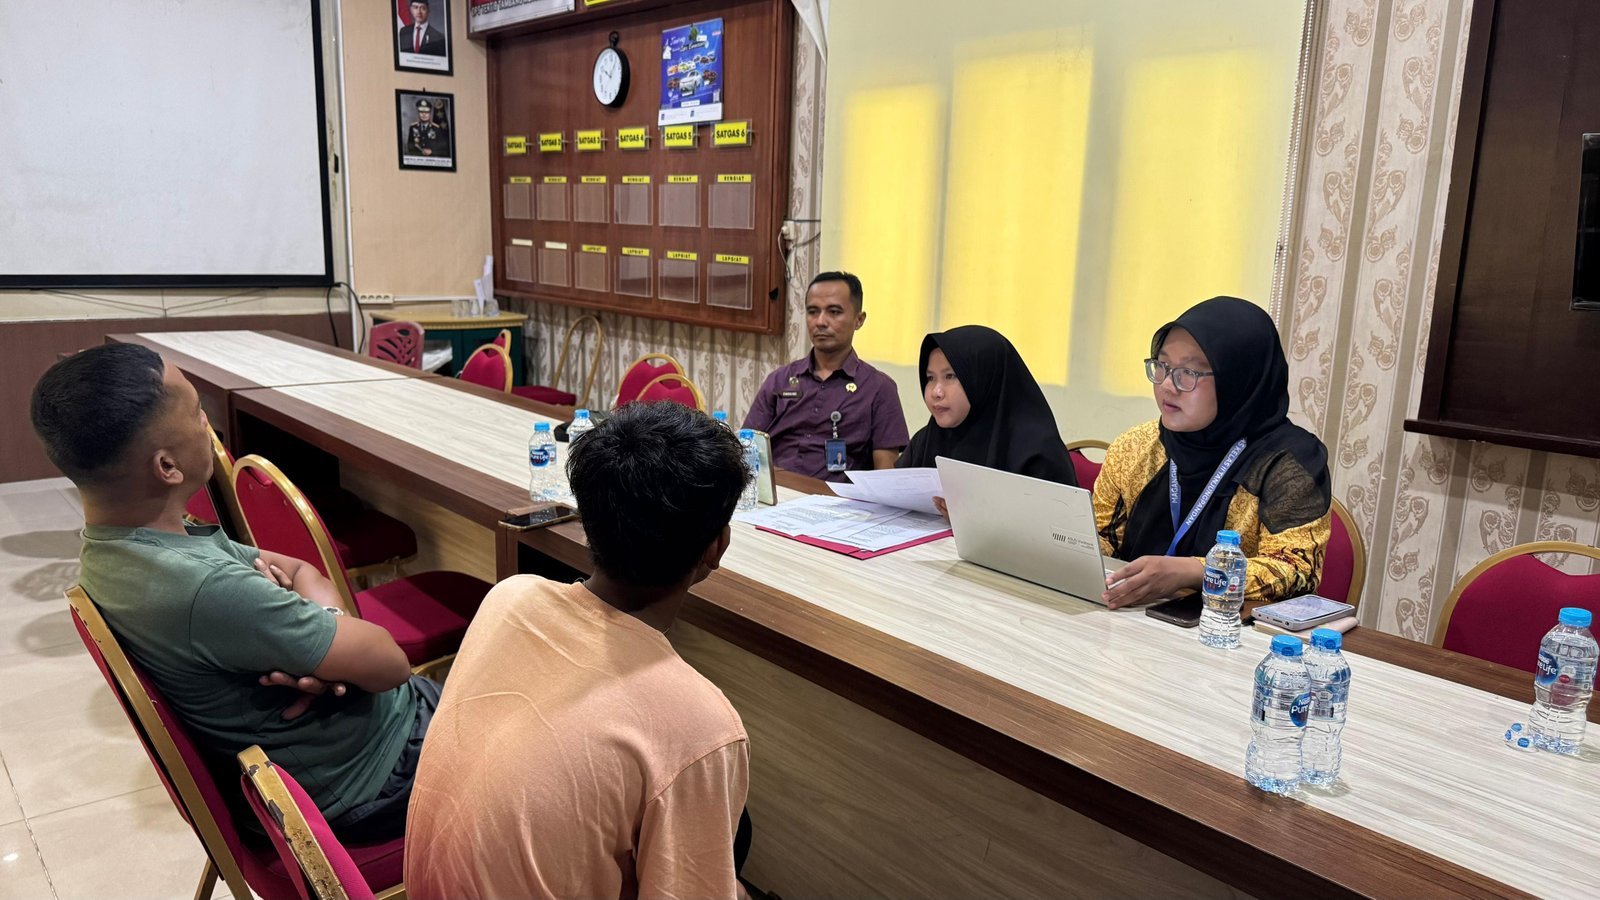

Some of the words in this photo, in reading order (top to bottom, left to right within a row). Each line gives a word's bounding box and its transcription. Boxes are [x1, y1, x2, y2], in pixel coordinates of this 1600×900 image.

[620, 134, 639, 142] SATGAS
[666, 132, 687, 140] SATGAS
[716, 130, 740, 139] SATGAS
[741, 128, 745, 137] 6
[579, 136, 596, 144] SATGAS
[1225, 447, 1241, 467] KELAS
[1170, 463, 1178, 504] MAGANGHU
[1186, 469, 1224, 526] TANJUNGPANDAN
[1214, 578, 1227, 588] Life
[1543, 664, 1556, 675] Life
[1291, 704, 1309, 714] Pur
